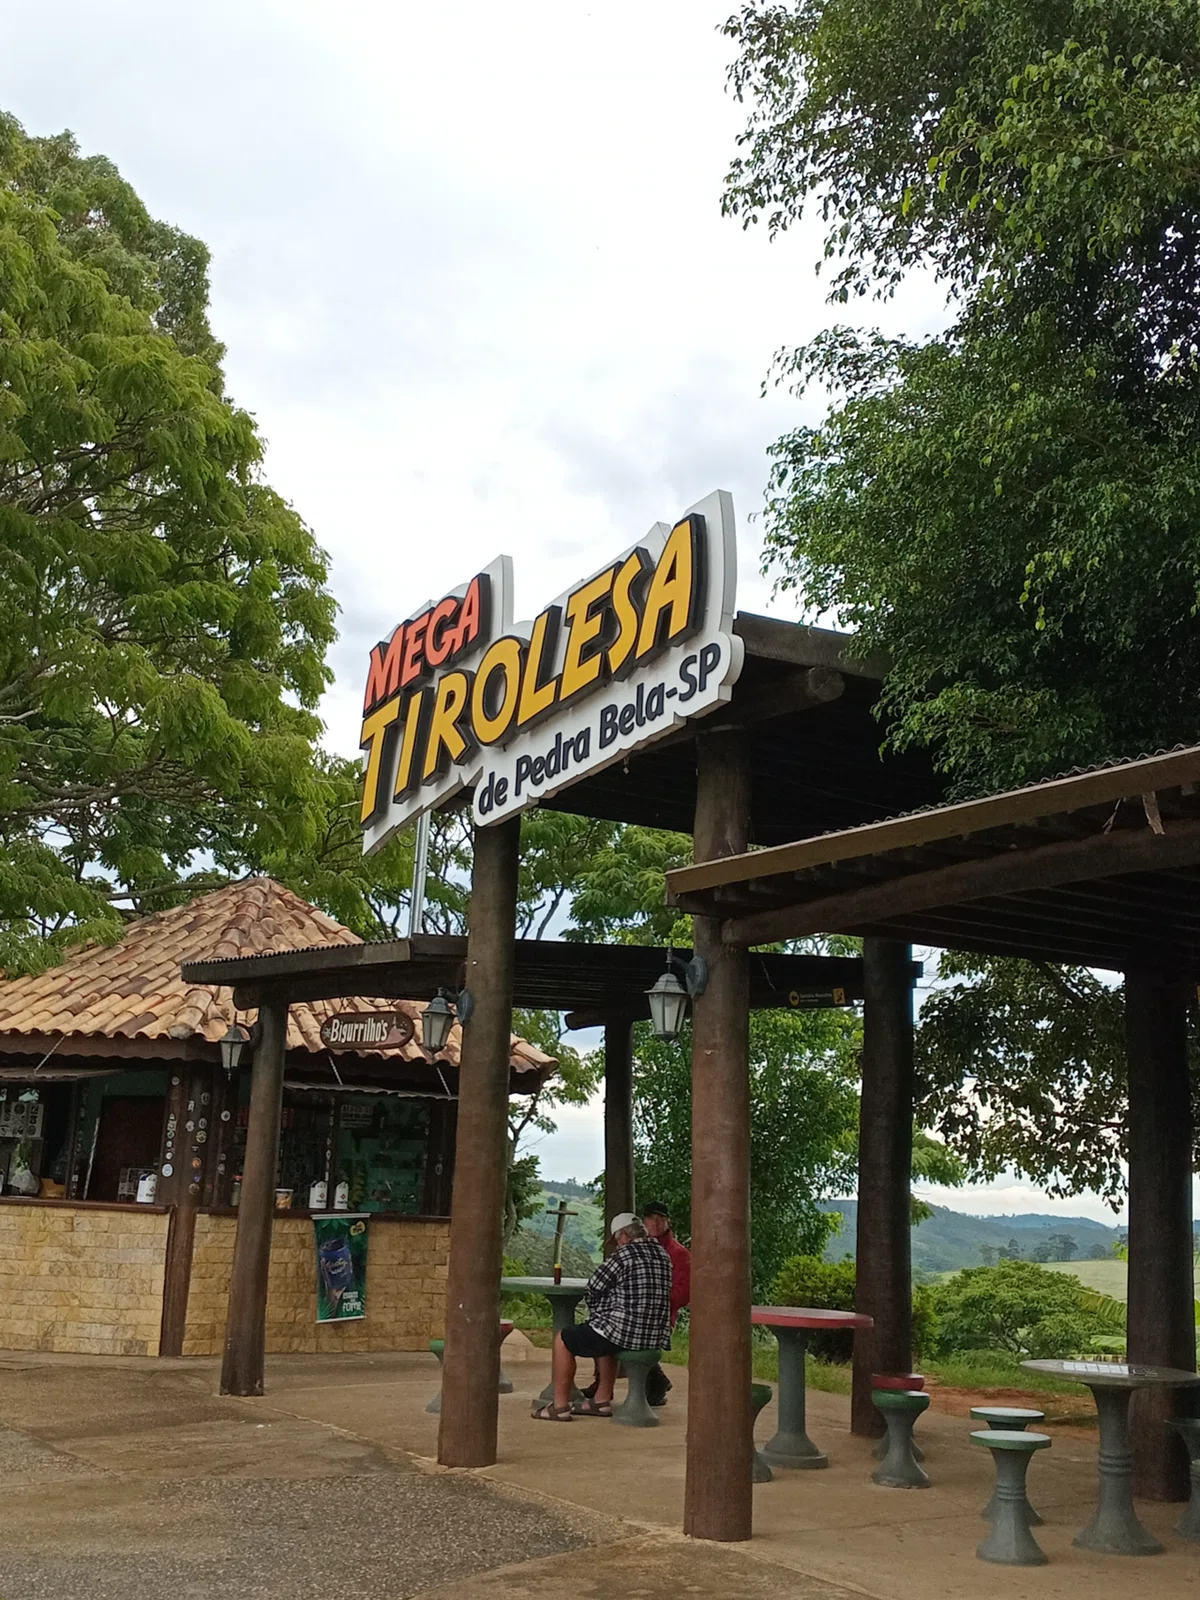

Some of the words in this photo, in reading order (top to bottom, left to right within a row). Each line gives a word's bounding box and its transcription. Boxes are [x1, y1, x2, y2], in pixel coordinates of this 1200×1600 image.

[360, 513, 705, 829] TIROLESA
[364, 573, 490, 717] MEGA
[478, 771, 508, 816] de
[514, 726, 591, 797] Pedra
[599, 643, 721, 749] Bela-SP
[330, 1017, 388, 1043] Bigurrilho's
